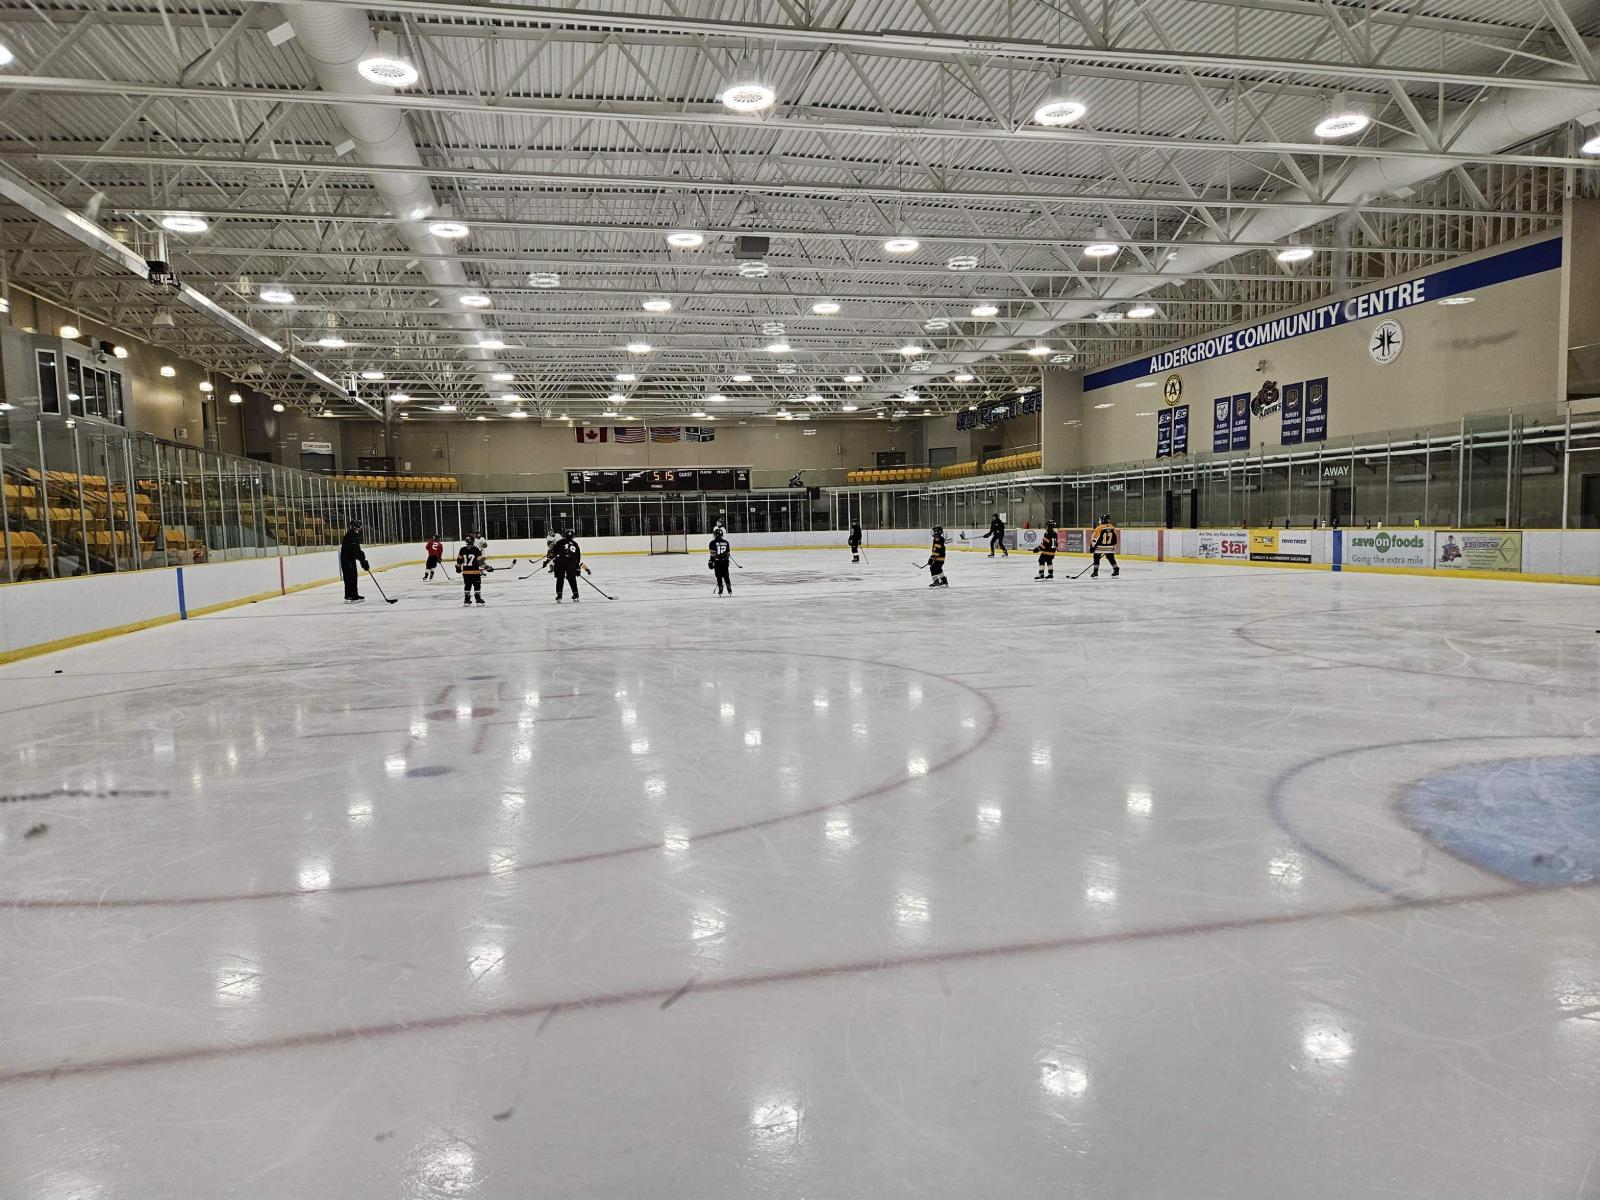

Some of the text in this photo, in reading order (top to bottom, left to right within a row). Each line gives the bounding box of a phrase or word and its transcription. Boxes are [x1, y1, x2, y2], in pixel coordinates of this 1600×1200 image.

[1149, 279, 1426, 374] ALDERGROVE COMMUNITY CENTRE
[653, 470, 674, 480] 5 15
[1323, 465, 1350, 477] AWAY
[1109, 484, 1125, 492] HOME
[1221, 540, 1248, 554] Star
[1352, 535, 1424, 548] save on foods
[462, 554, 476, 566] 17
[1352, 555, 1424, 565] Going the extra mile
